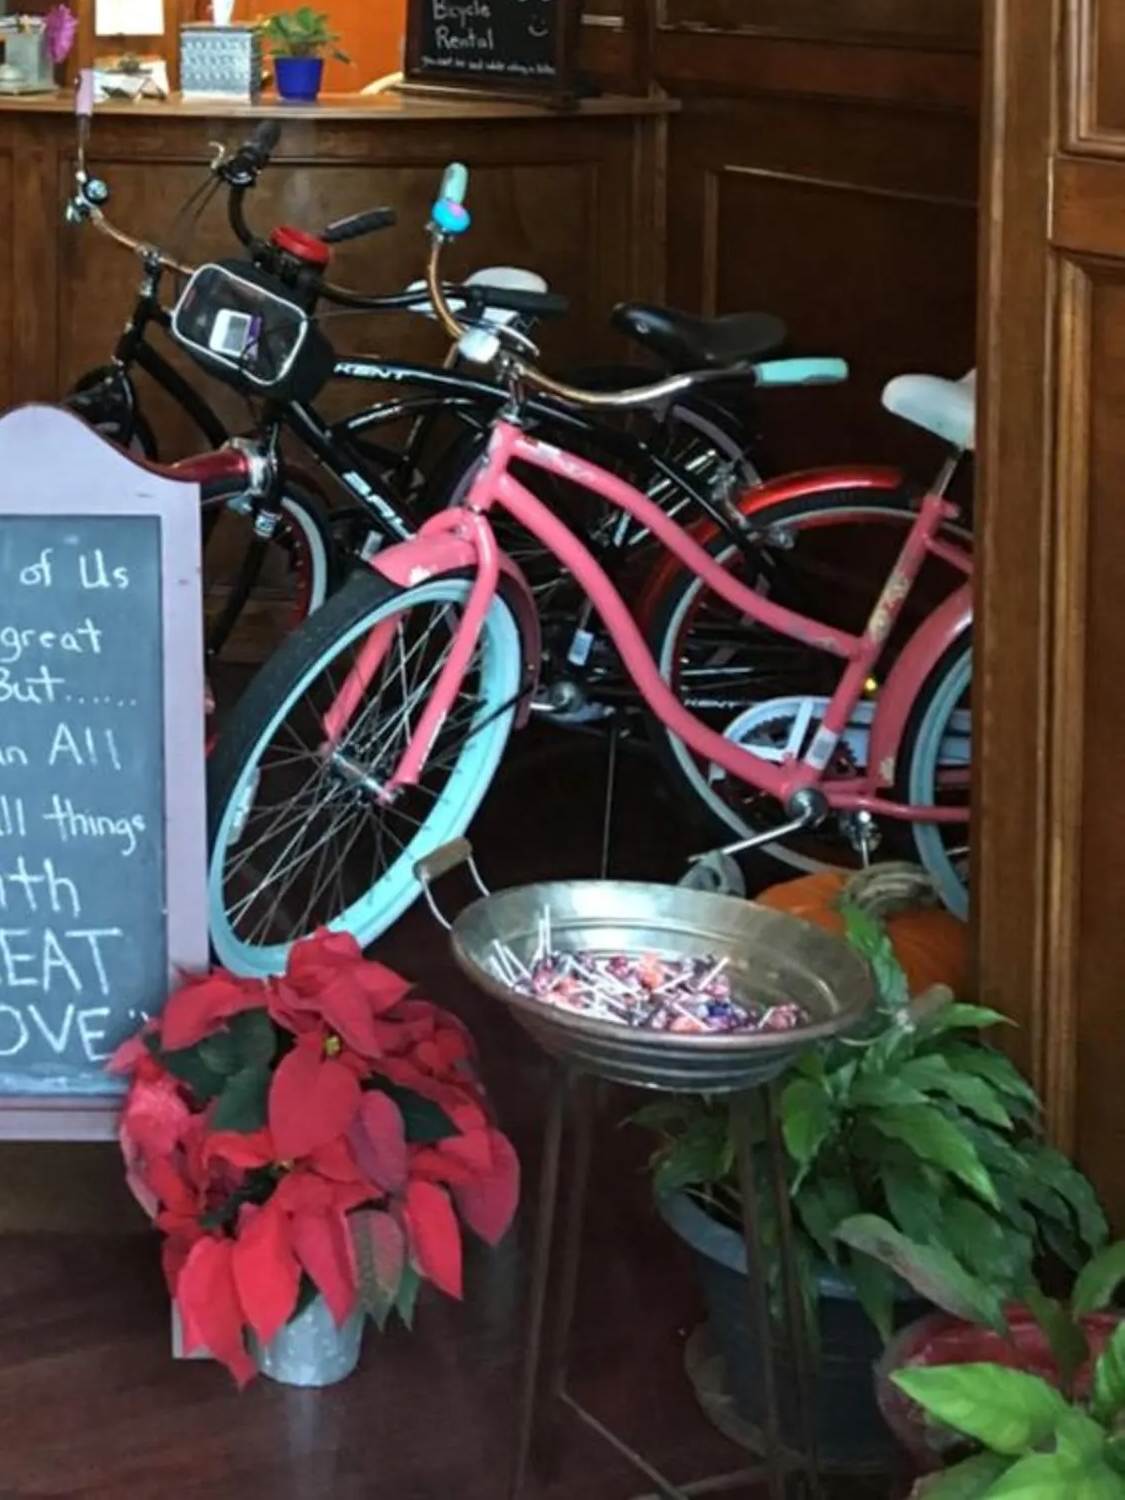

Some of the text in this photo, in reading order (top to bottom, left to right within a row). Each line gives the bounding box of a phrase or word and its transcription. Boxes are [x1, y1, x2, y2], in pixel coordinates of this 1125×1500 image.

[435, 25, 494, 50] Rental
[19, 548, 53, 587] of
[80, 549, 129, 589] Us
[0, 618, 102, 663] great
[48, 722, 121, 770] All
[43, 794, 145, 855] things
